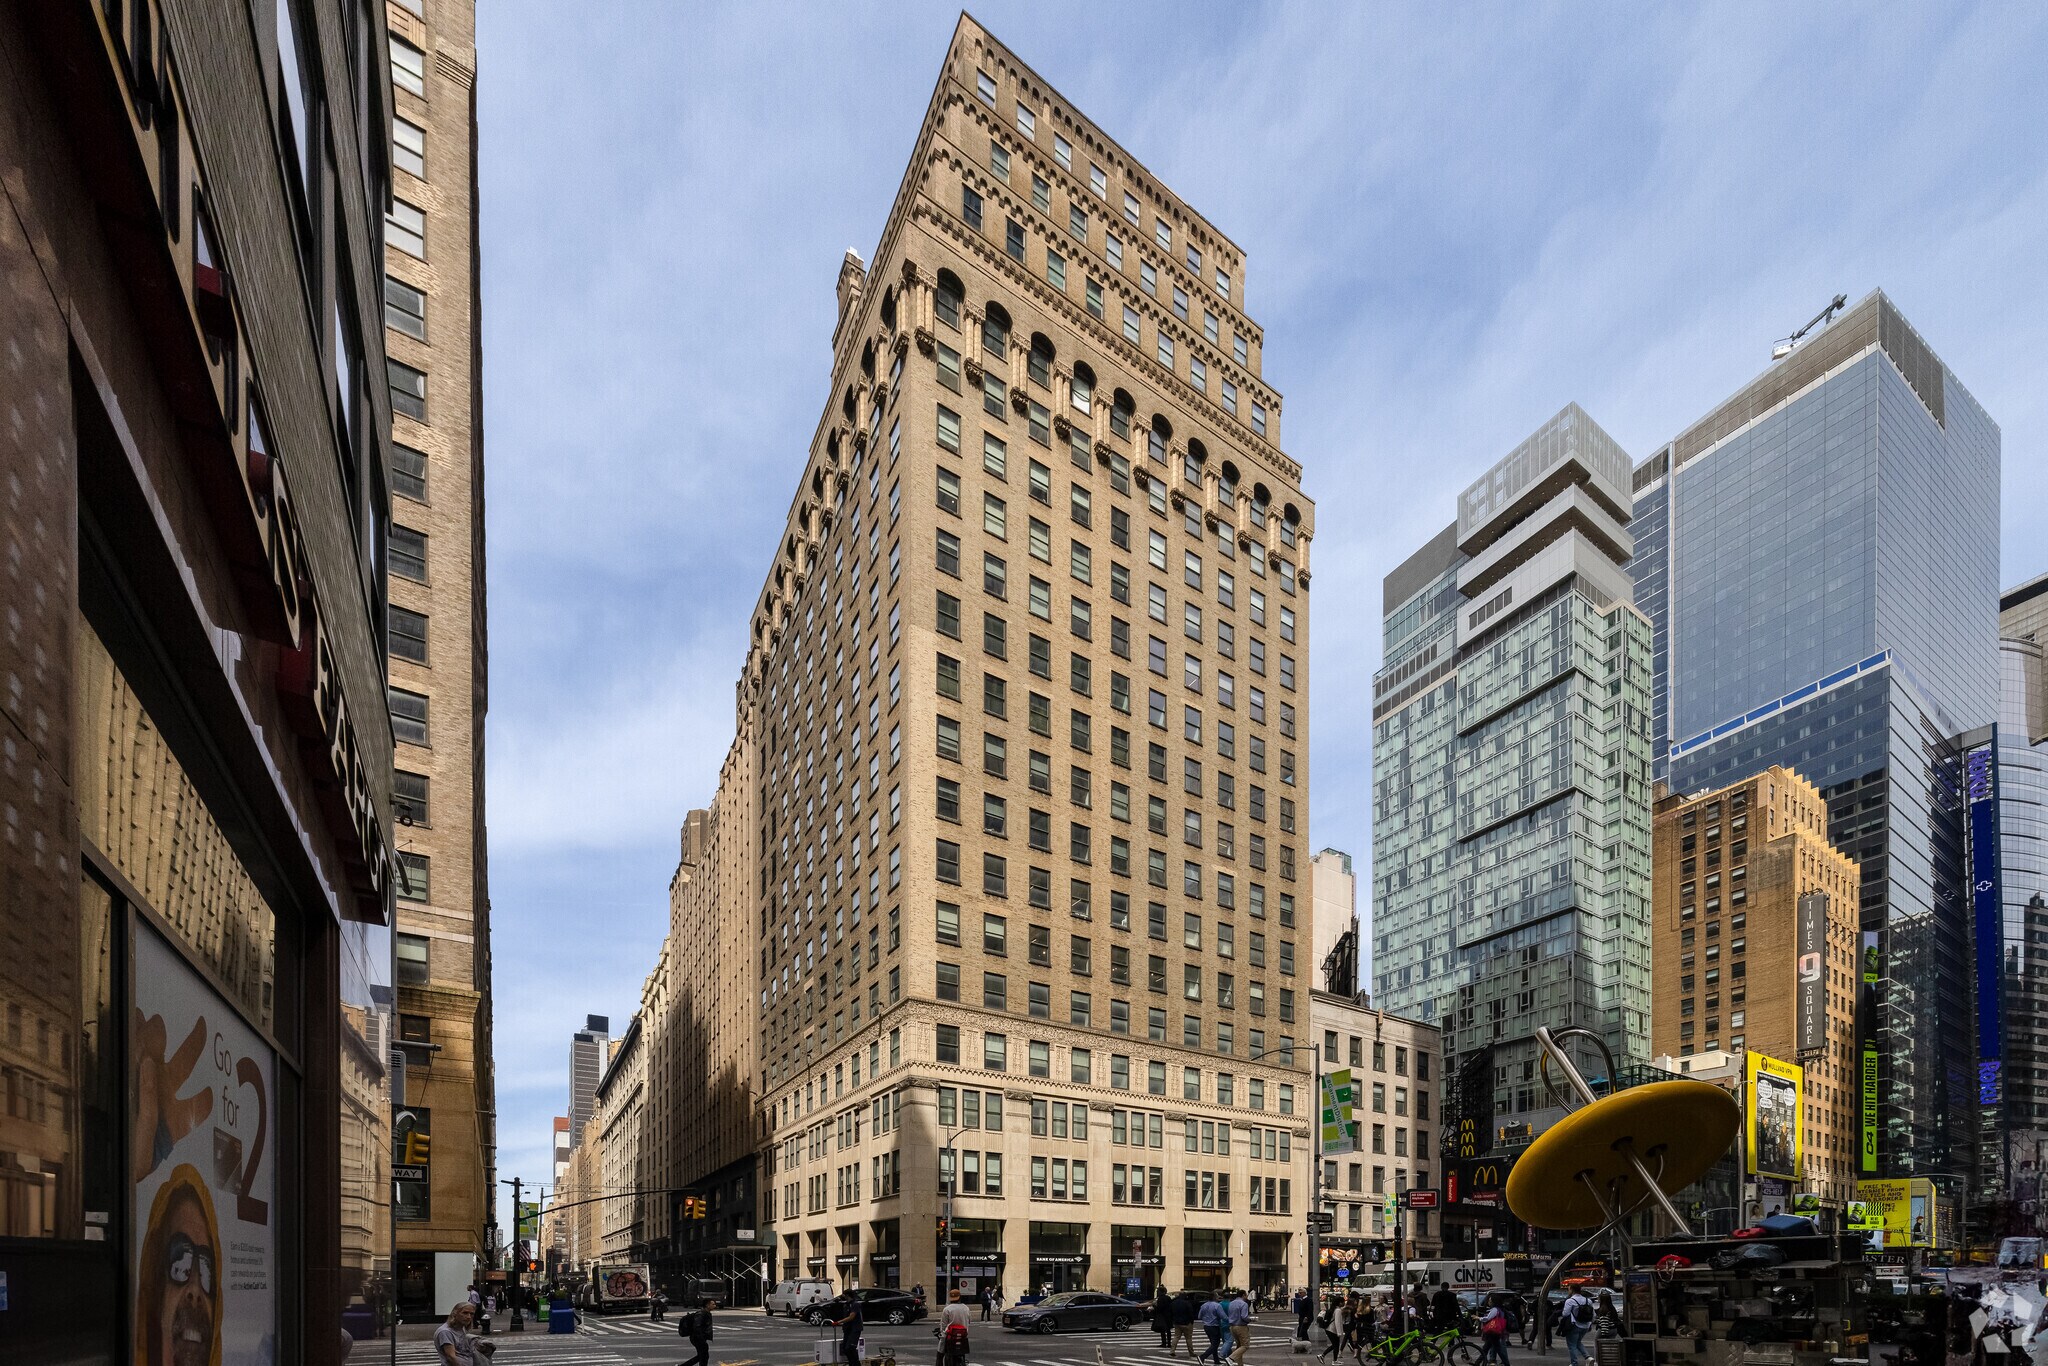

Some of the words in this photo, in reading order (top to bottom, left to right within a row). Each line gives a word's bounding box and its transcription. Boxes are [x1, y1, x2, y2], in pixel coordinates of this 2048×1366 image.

[1806, 900, 1814, 950] TIMES
[1805, 985, 1813, 1045] SQUARE
[213, 1031, 232, 1077] Go
[1768, 1063, 1785, 1074] MULLVAD
[1865, 1057, 1876, 1094] HARDER
[1978, 1060, 2001, 1105] ROKU
[222, 1085, 240, 1129] for
[1326, 1079, 1346, 1135] #GarmentDistrict
[1865, 1096, 1876, 1111] HIT
[1865, 1112, 1876, 1127] WE
[235, 1056, 269, 1226] 2
[1866, 1131, 1874, 1156] C4
[394, 1169, 418, 1178] WAY
[1462, 1197, 1496, 1207] McDonald's
[1861, 1254, 1905, 1264] BSTER
